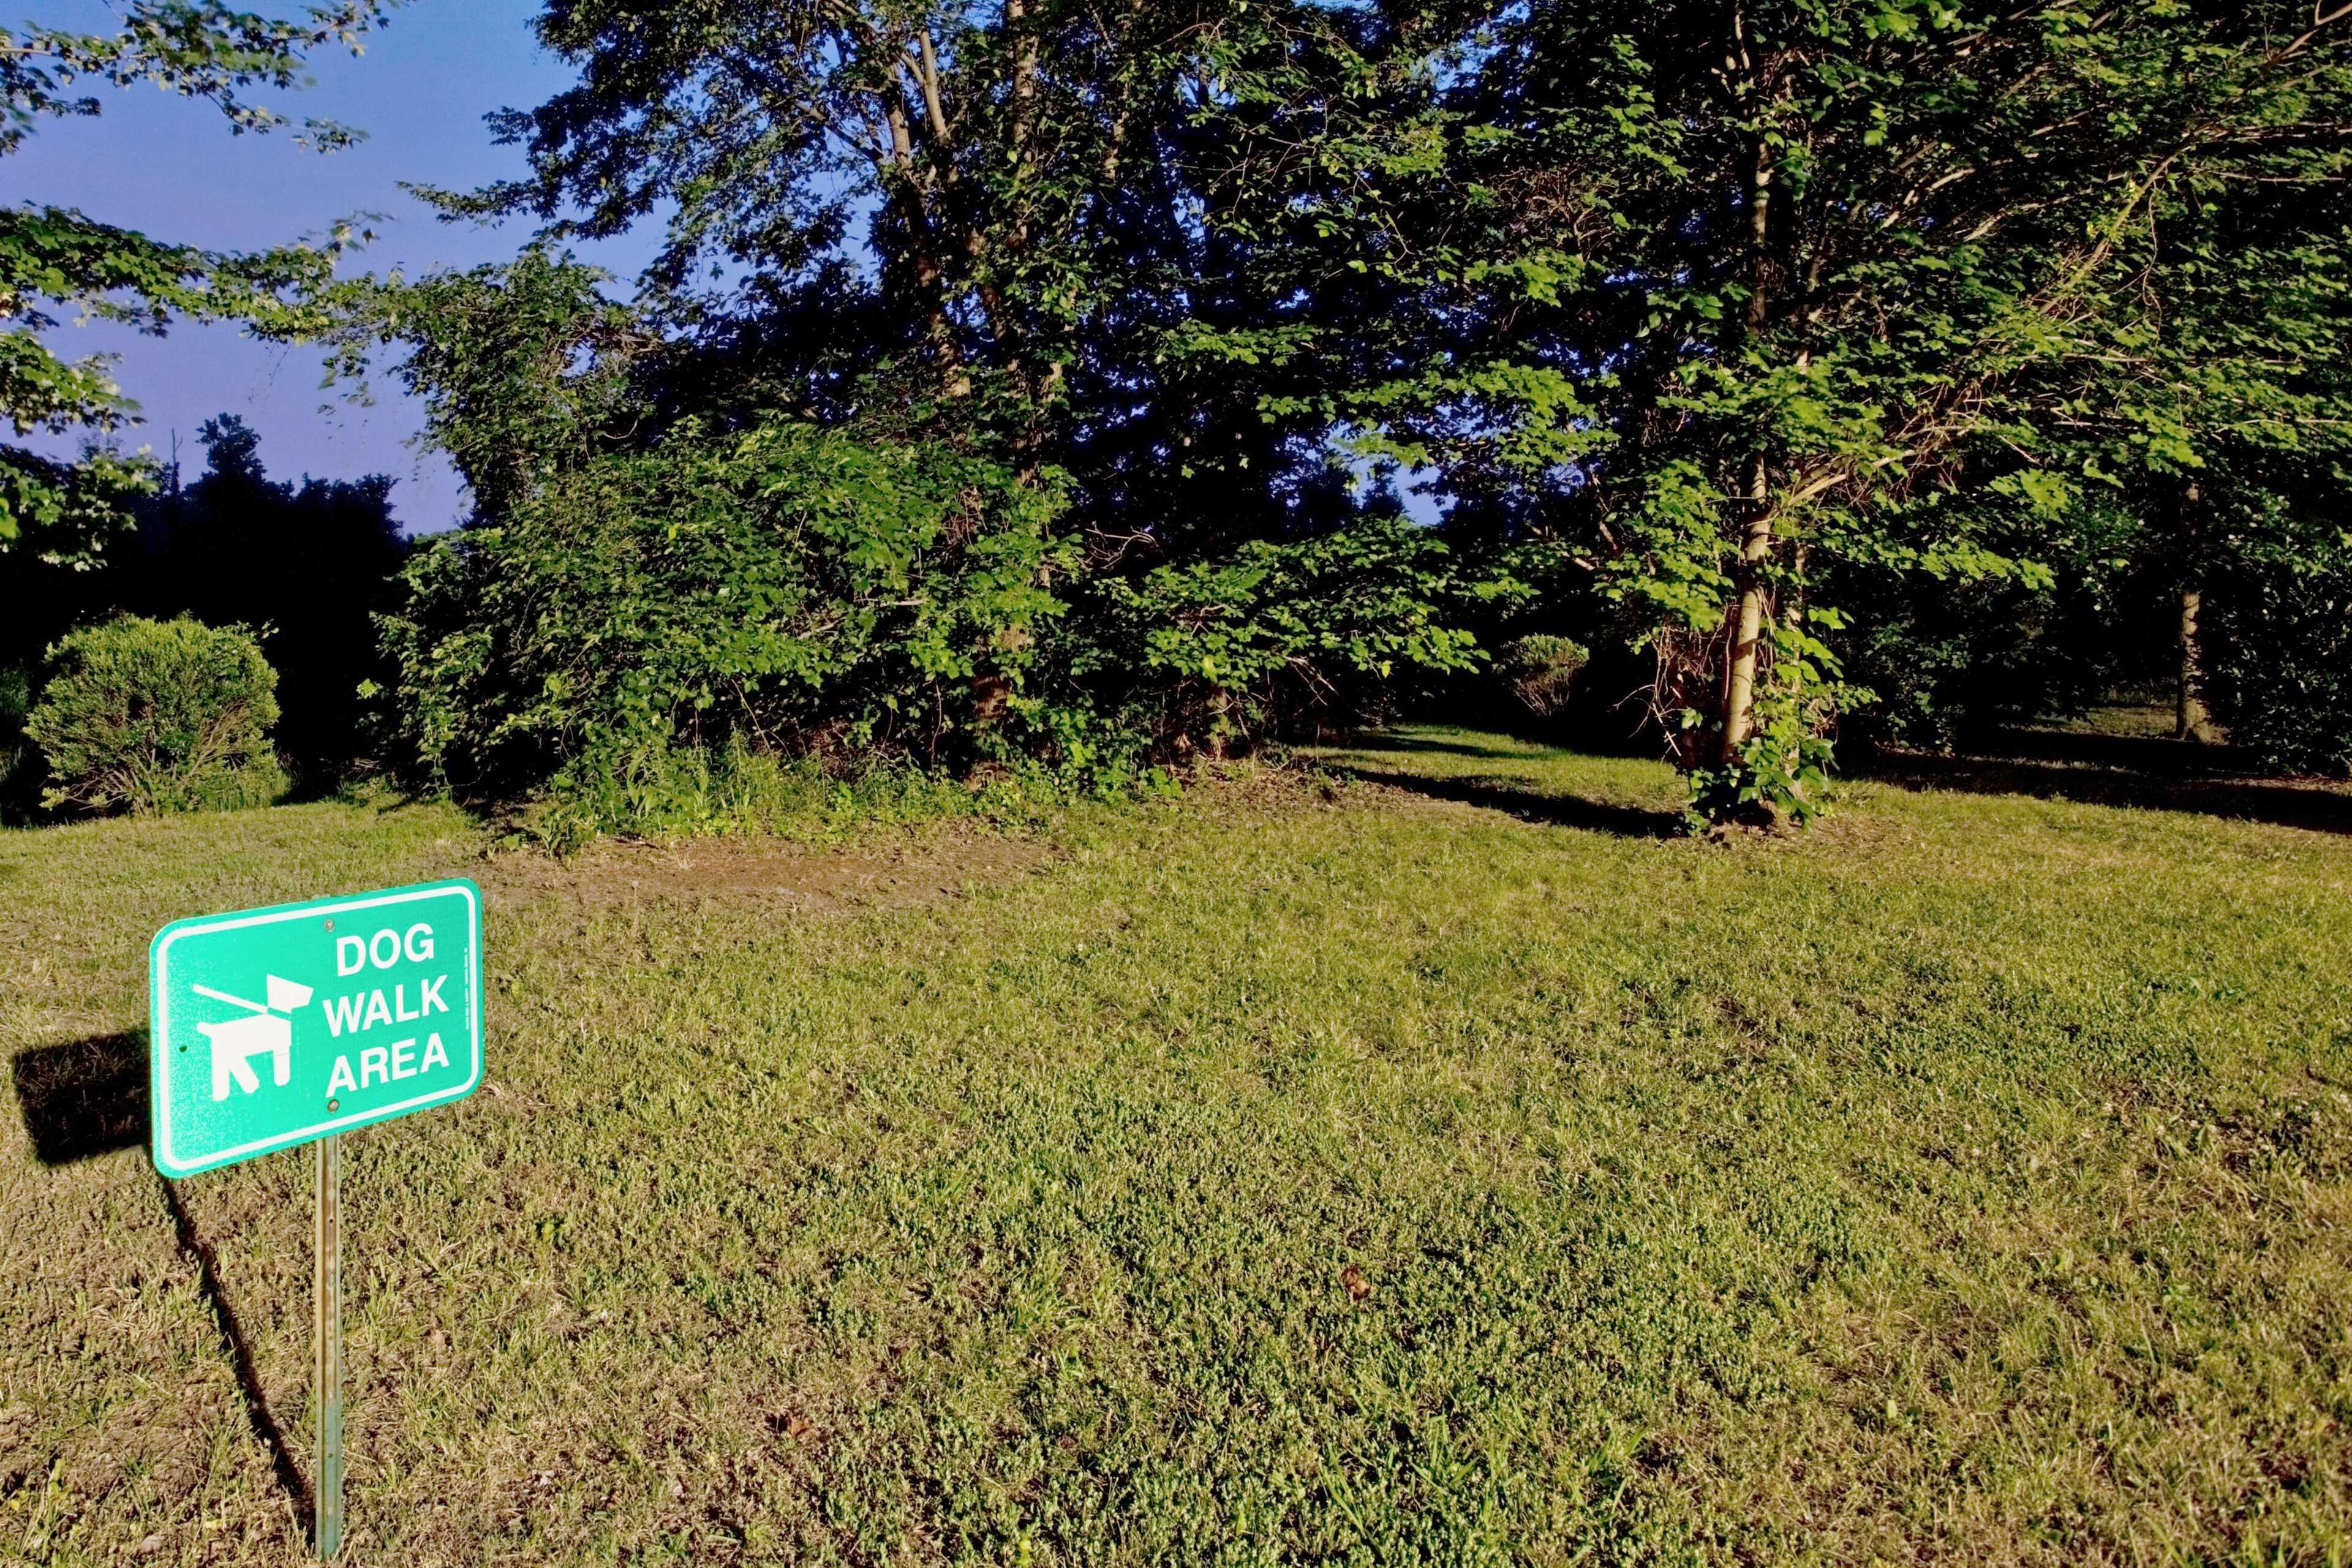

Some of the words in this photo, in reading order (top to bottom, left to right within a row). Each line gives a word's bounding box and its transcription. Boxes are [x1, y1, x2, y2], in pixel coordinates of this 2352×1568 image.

[337, 923, 434, 976] DOG
[322, 974, 449, 1037] WALK
[325, 1033, 450, 1098] AREA
